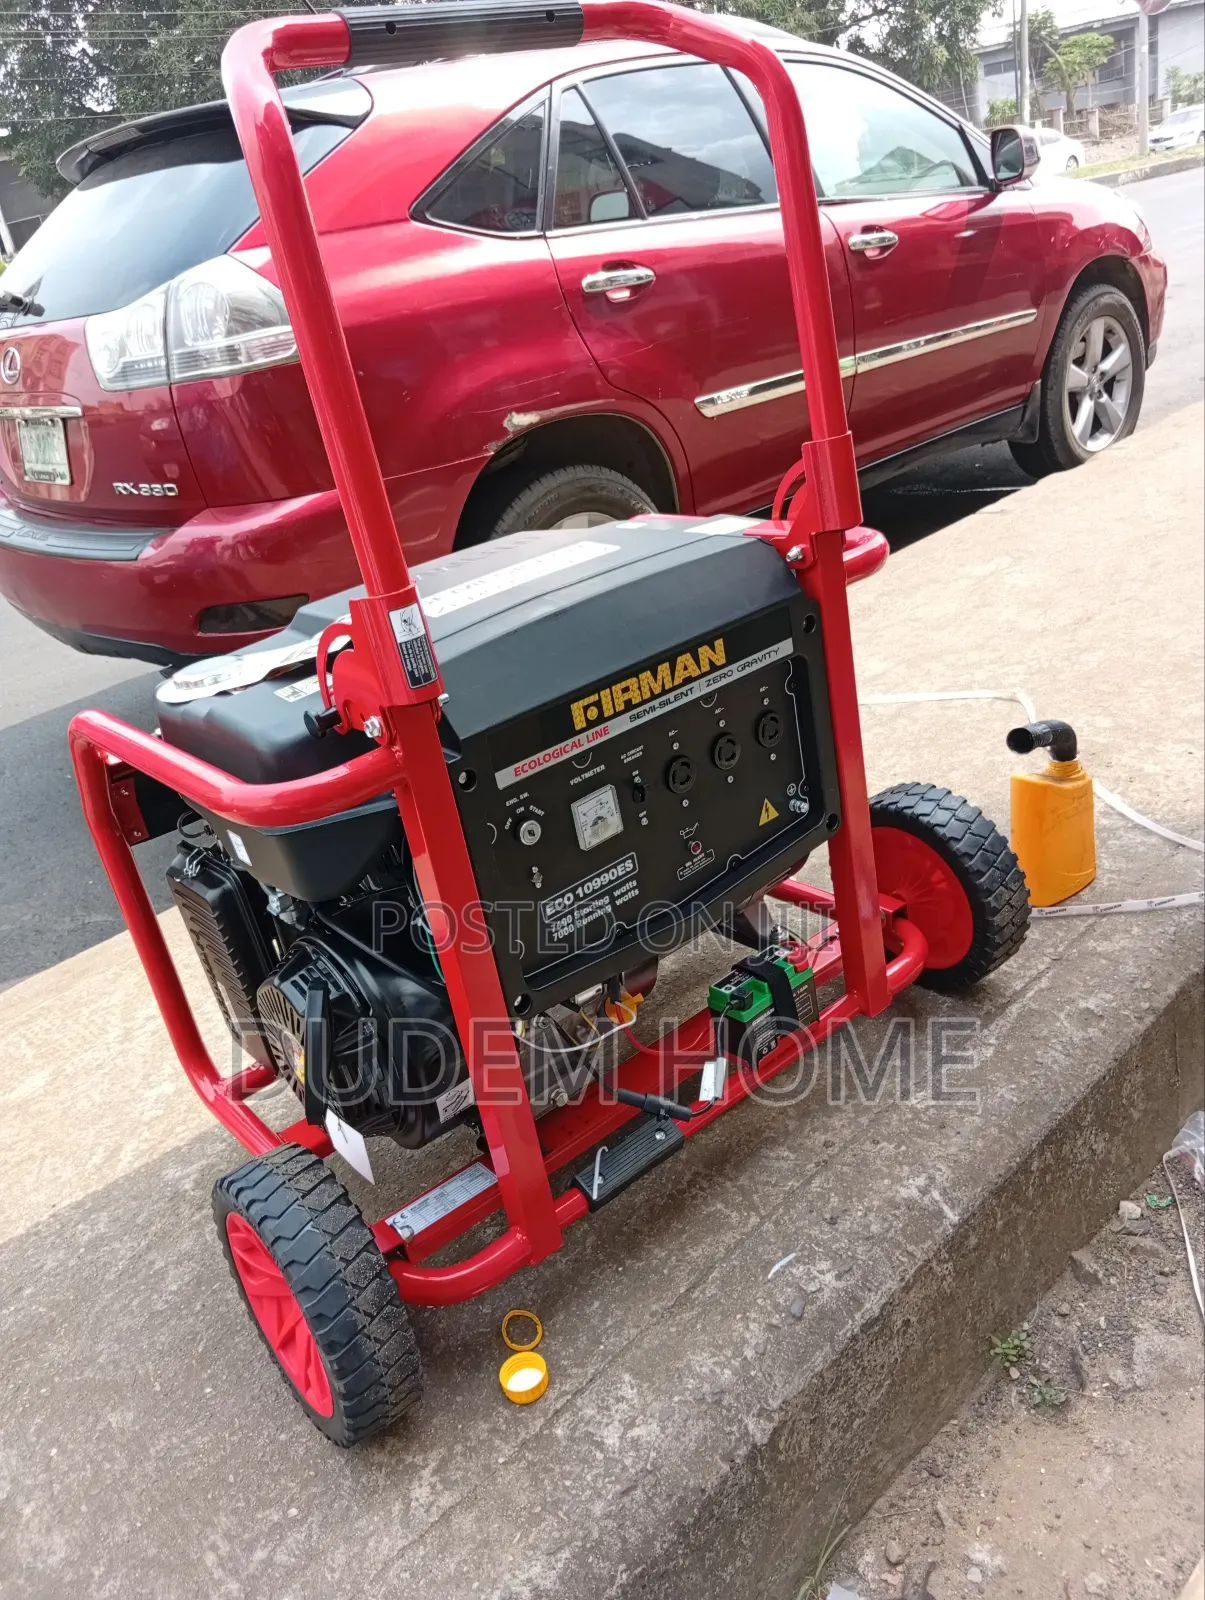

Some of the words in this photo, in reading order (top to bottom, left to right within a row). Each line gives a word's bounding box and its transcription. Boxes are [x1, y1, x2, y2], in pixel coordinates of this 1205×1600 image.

[570, 638, 727, 731] FIRMAN
[628, 686, 695, 723] SEMI-SILENT
[704, 670, 734, 688] ZERO
[736, 647, 781, 673] GRAVITY
[513, 739, 584, 777] ECOLOGICAL
[586, 725, 610, 744] LINE
[569, 764, 606, 786] VOLTMETER
[504, 817, 513, 830] OFF
[515, 806, 525, 814] ON
[529, 805, 545, 817] START
[545, 892, 574, 917] ECO
[575, 859, 634, 899] 10990ES
[573, 895, 610, 920] Starting
[613, 879, 637, 897] watts
[552, 923, 575, 942] 7000
[575, 904, 612, 929] Running
[615, 887, 639, 906] watts
